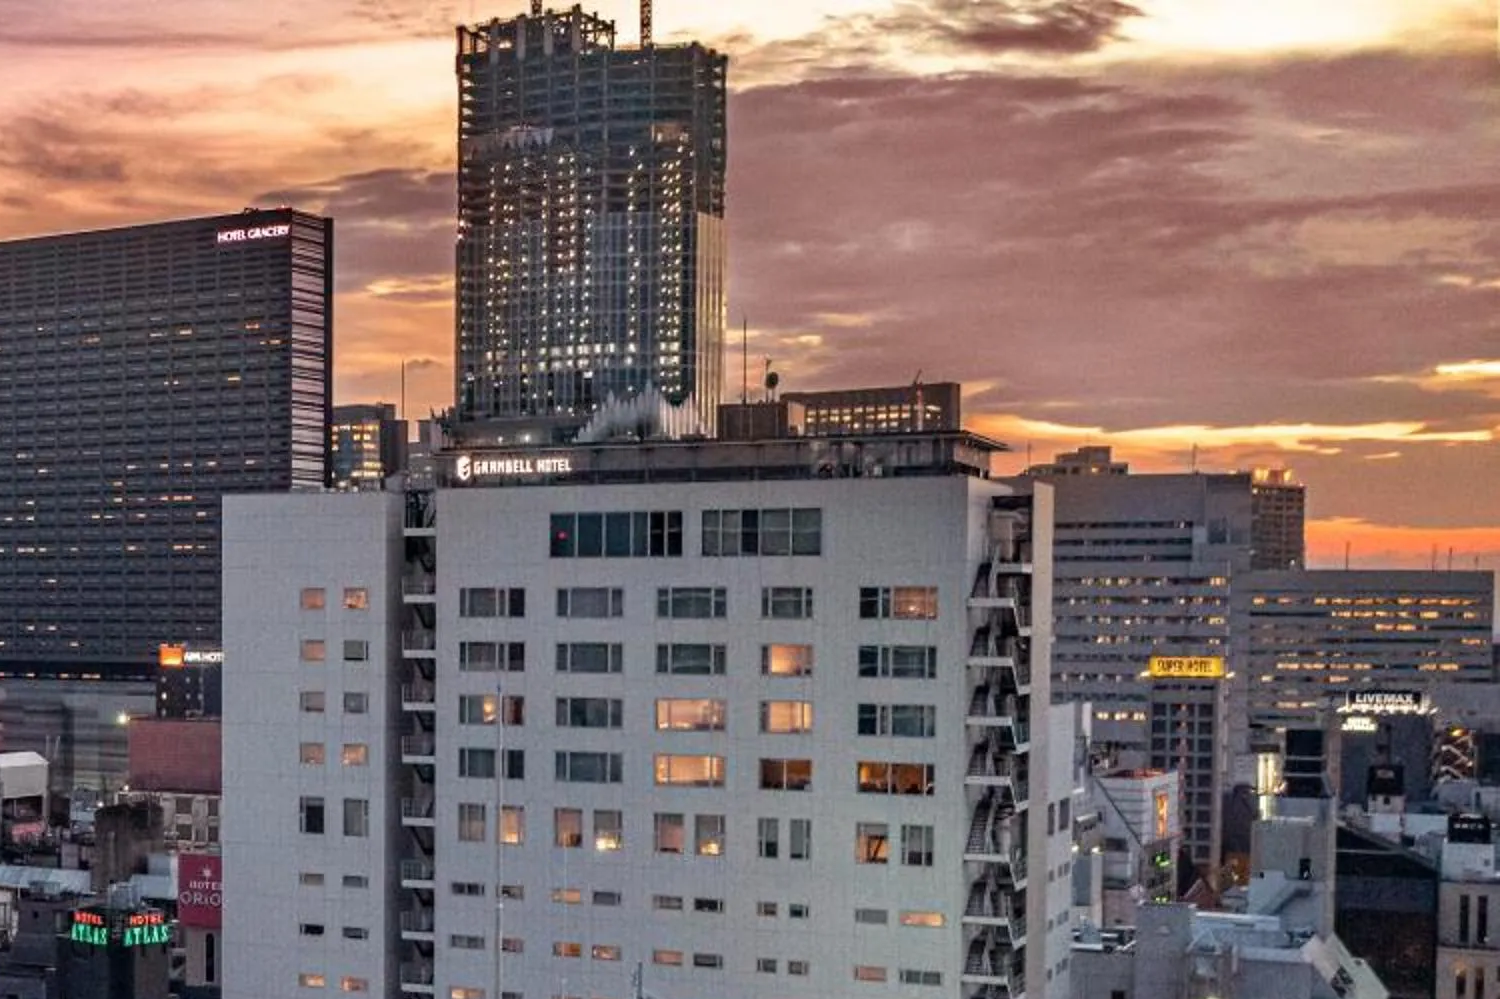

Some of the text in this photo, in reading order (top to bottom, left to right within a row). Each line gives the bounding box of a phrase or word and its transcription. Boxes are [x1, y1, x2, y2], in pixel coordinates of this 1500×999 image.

[217, 230, 246, 243] HOTEL
[536, 458, 572, 473] HOTEL
[1355, 692, 1414, 704] LIVEMAX
[189, 881, 223, 890] HOTE
[74, 911, 104, 926] HOTEL
[130, 912, 165, 926] HOTEL
[71, 922, 108, 945] ATLAS
[124, 923, 170, 947] ATLAS
